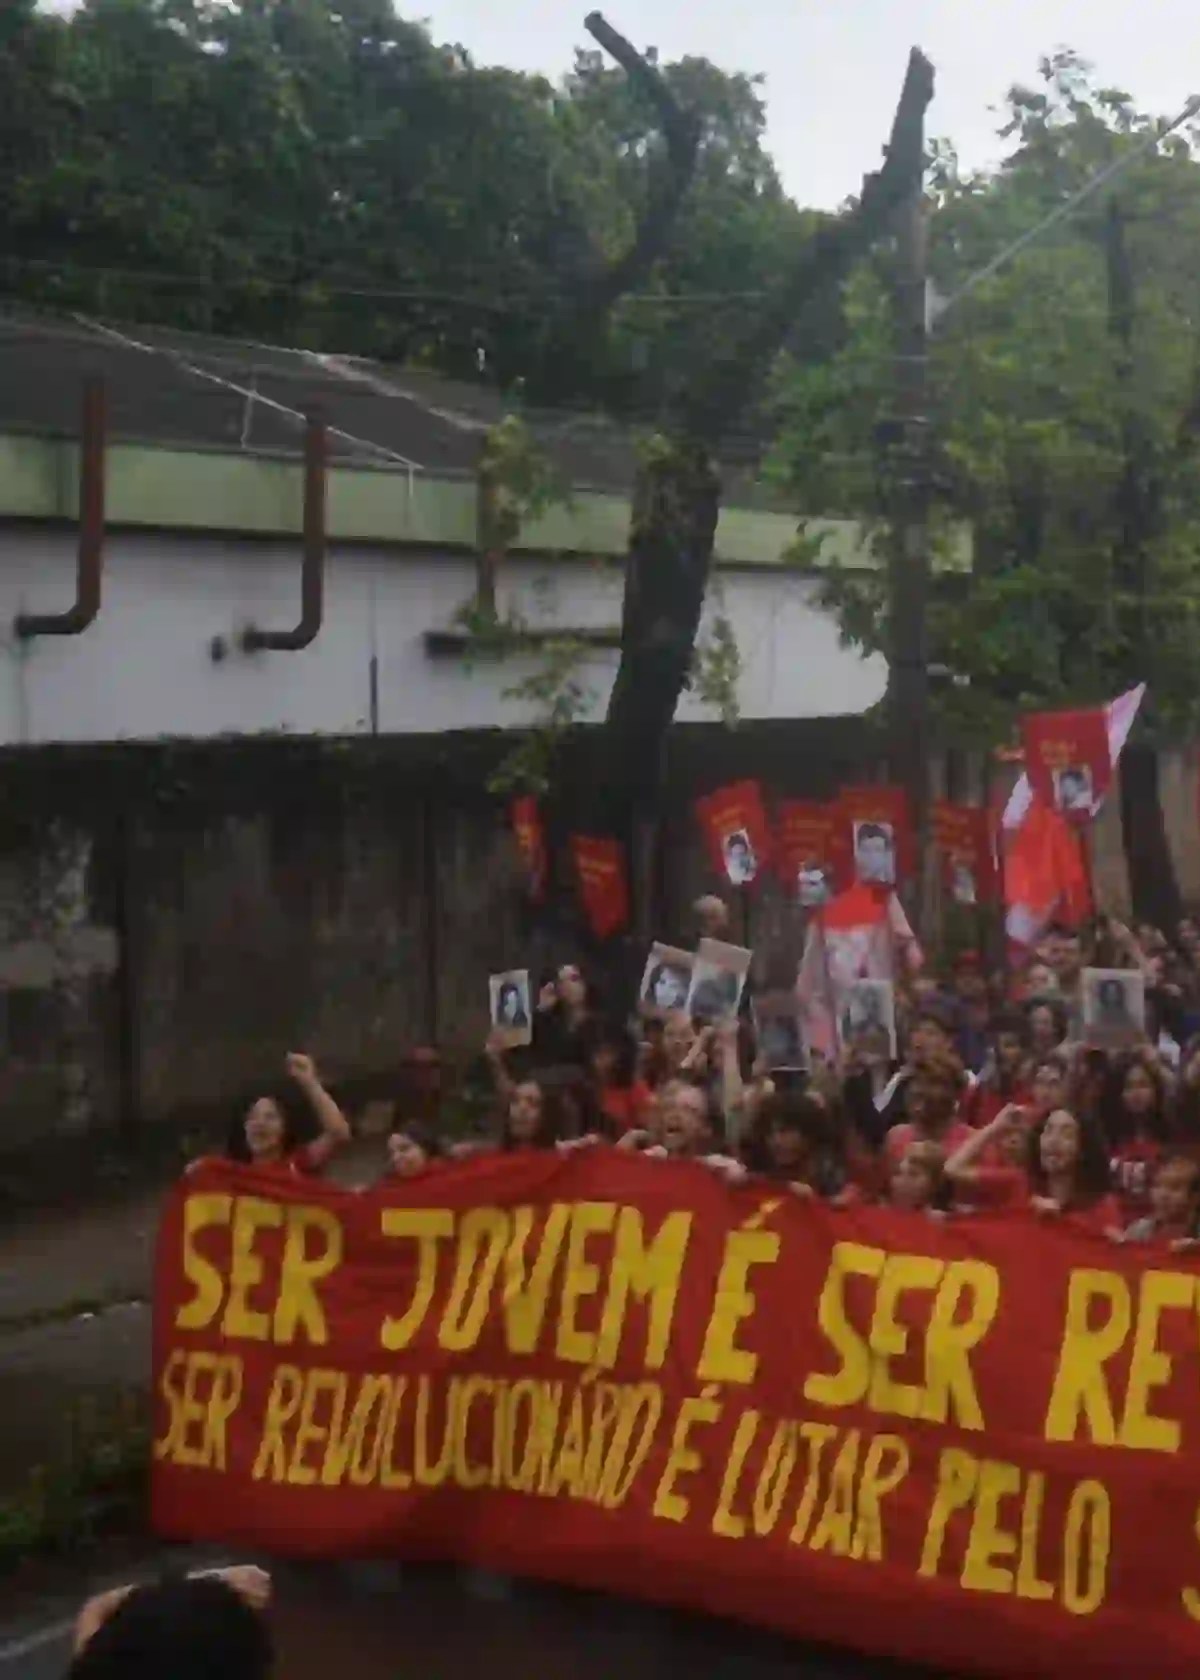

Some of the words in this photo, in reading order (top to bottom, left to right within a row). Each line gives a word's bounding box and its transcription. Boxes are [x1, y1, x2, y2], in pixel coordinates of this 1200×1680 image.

[176, 1194, 341, 1345] SER
[380, 1202, 692, 1370] JOVEM
[697, 1200, 780, 1384] É
[803, 1242, 1000, 1431] SER
[153, 1348, 243, 1472] SER
[252, 1364, 663, 1508] REVOLUCIONÁRIO
[653, 1384, 722, 1522] É
[712, 1410, 910, 1560] LUTAR
[917, 1447, 1110, 1615] PELO
